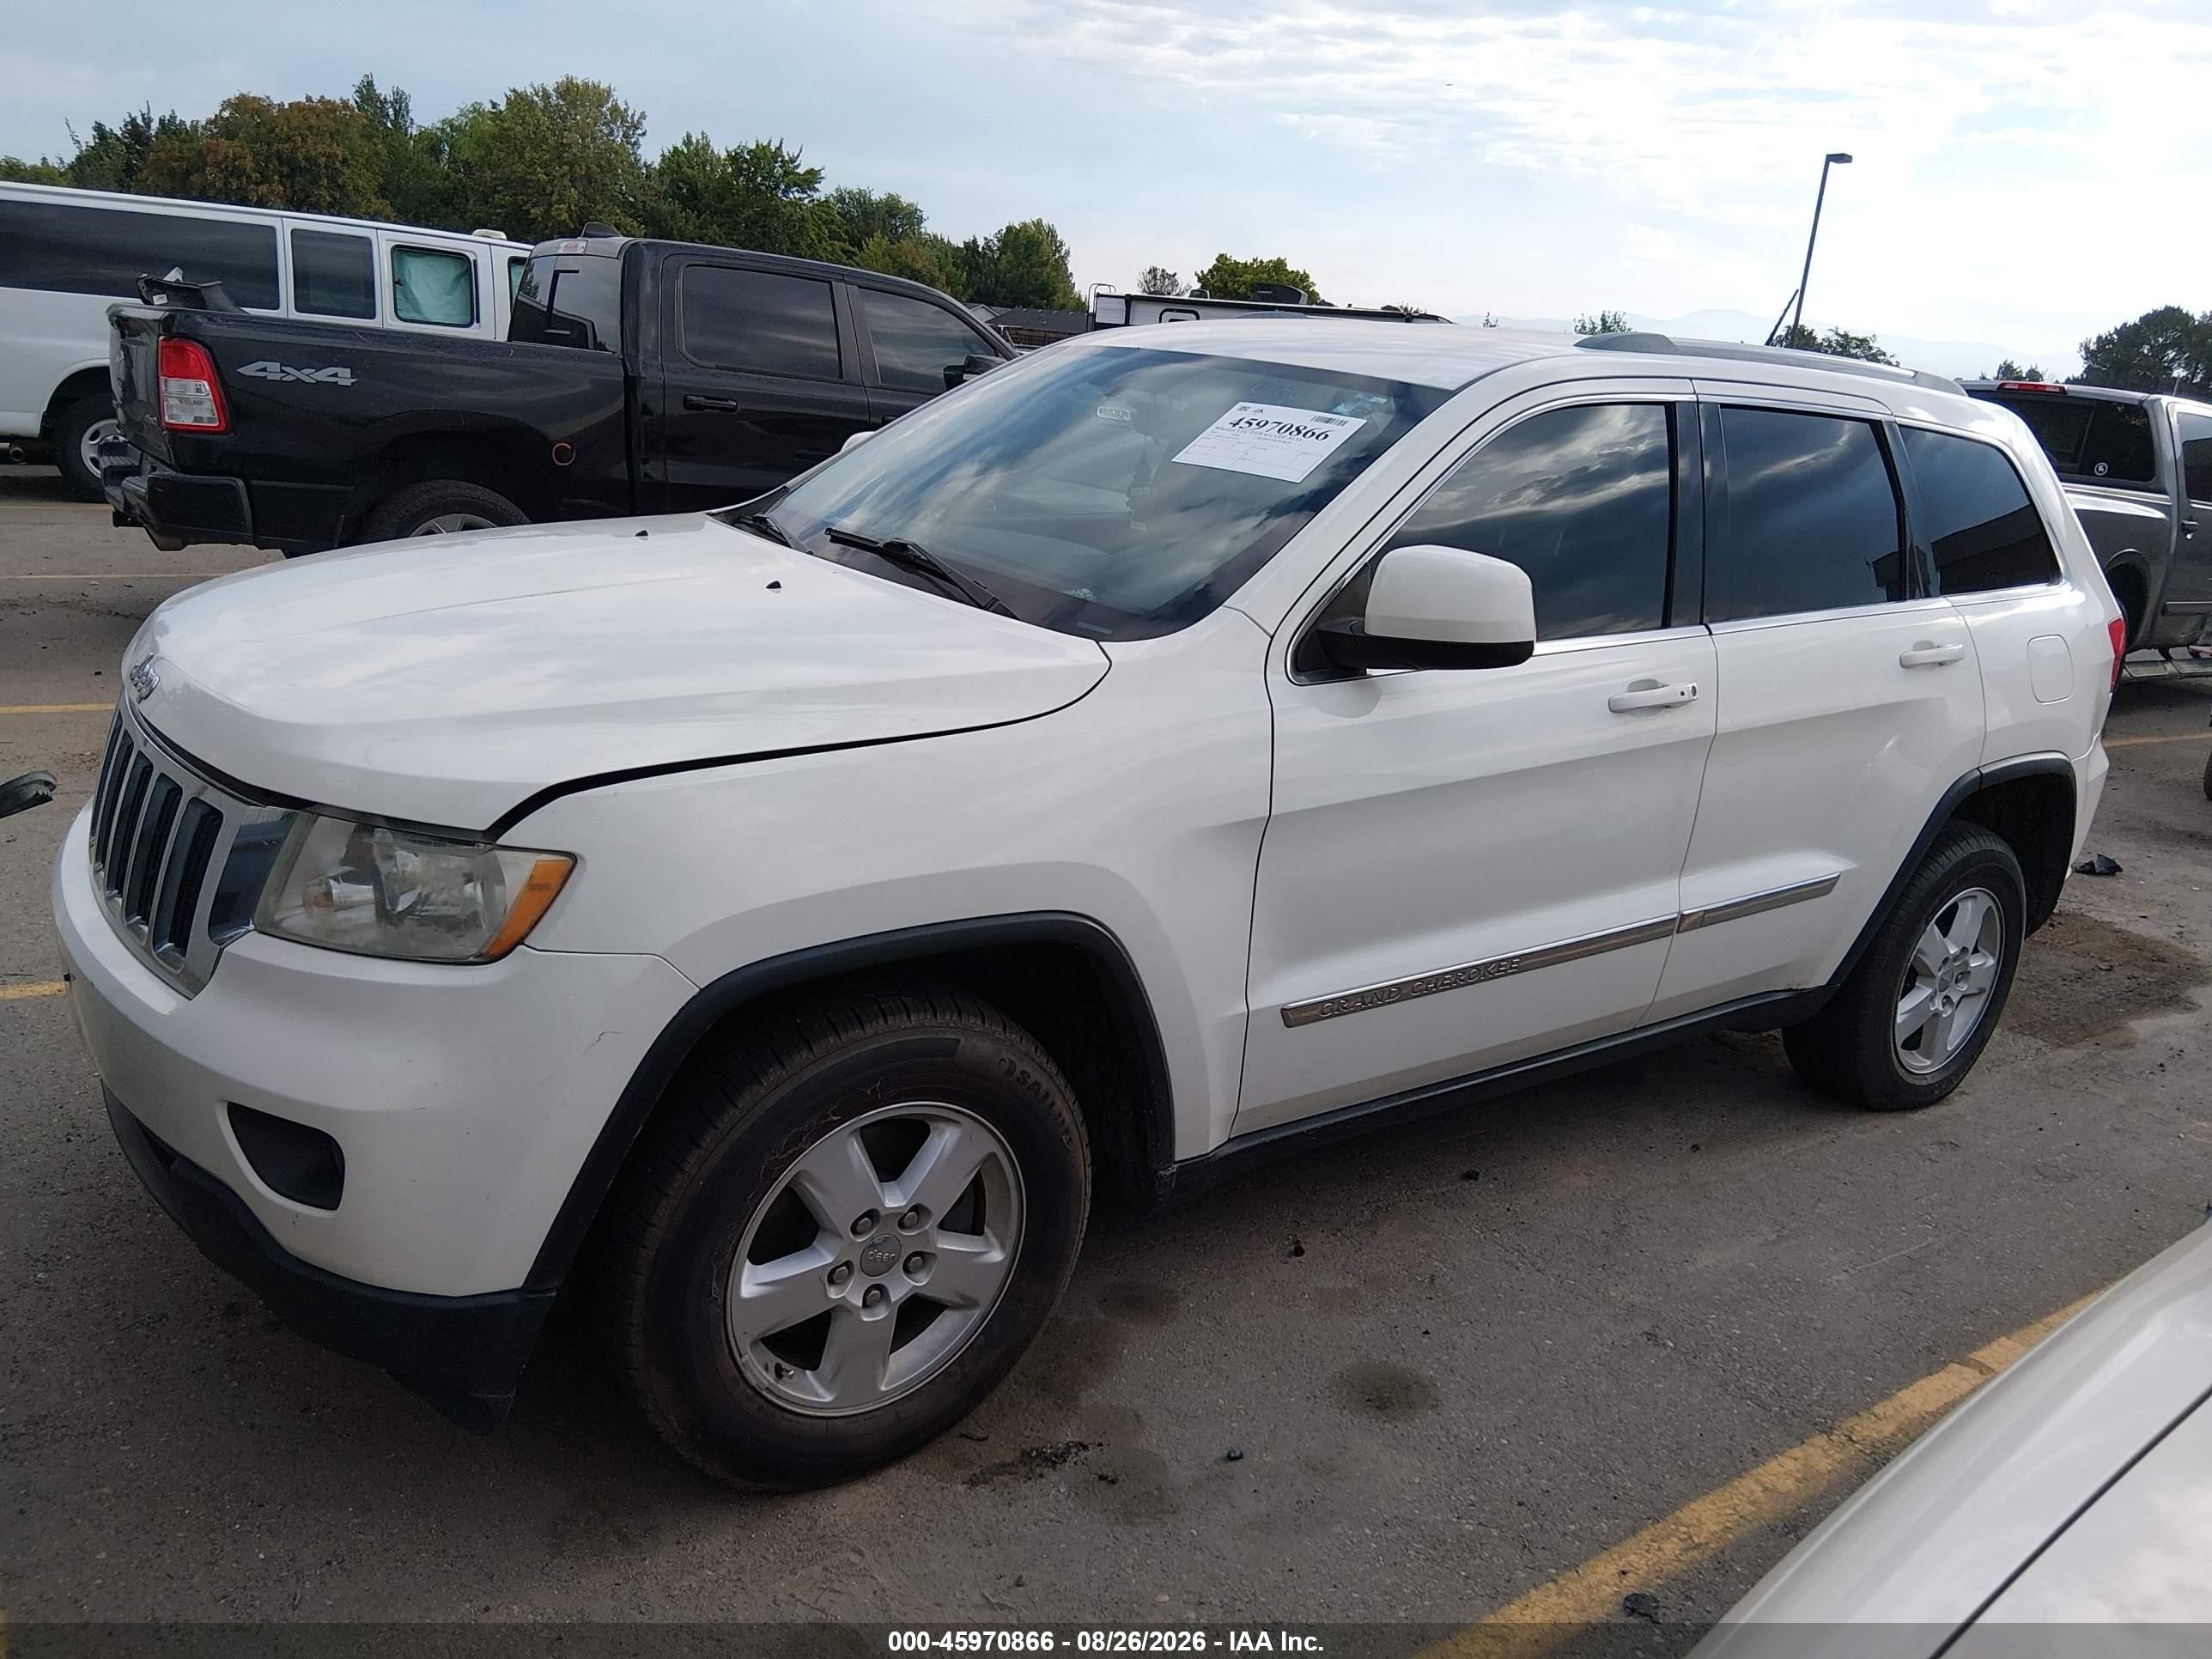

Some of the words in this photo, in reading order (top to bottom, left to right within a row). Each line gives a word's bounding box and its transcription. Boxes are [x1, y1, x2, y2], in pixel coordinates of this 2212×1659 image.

[1229, 416, 1334, 441] 45970866
[1318, 987, 1401, 1018] GRAND
[1410, 957, 1521, 998] CHEROKEE
